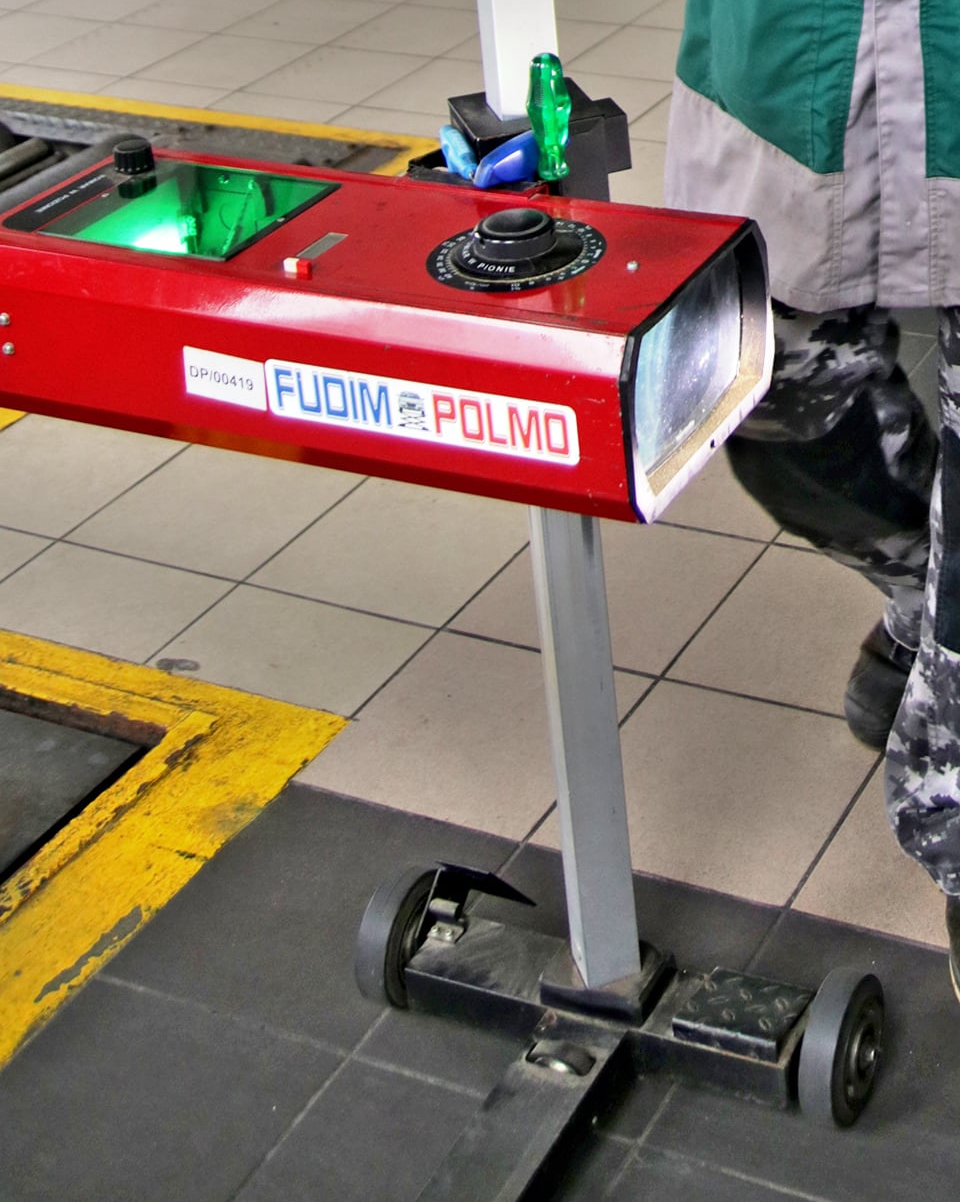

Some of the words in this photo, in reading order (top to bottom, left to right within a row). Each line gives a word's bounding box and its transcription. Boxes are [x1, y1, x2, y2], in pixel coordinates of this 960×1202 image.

[477, 262, 516, 273] PIONIE
[273, 367, 393, 427] FUDIM
[432, 390, 570, 456] POLMO
